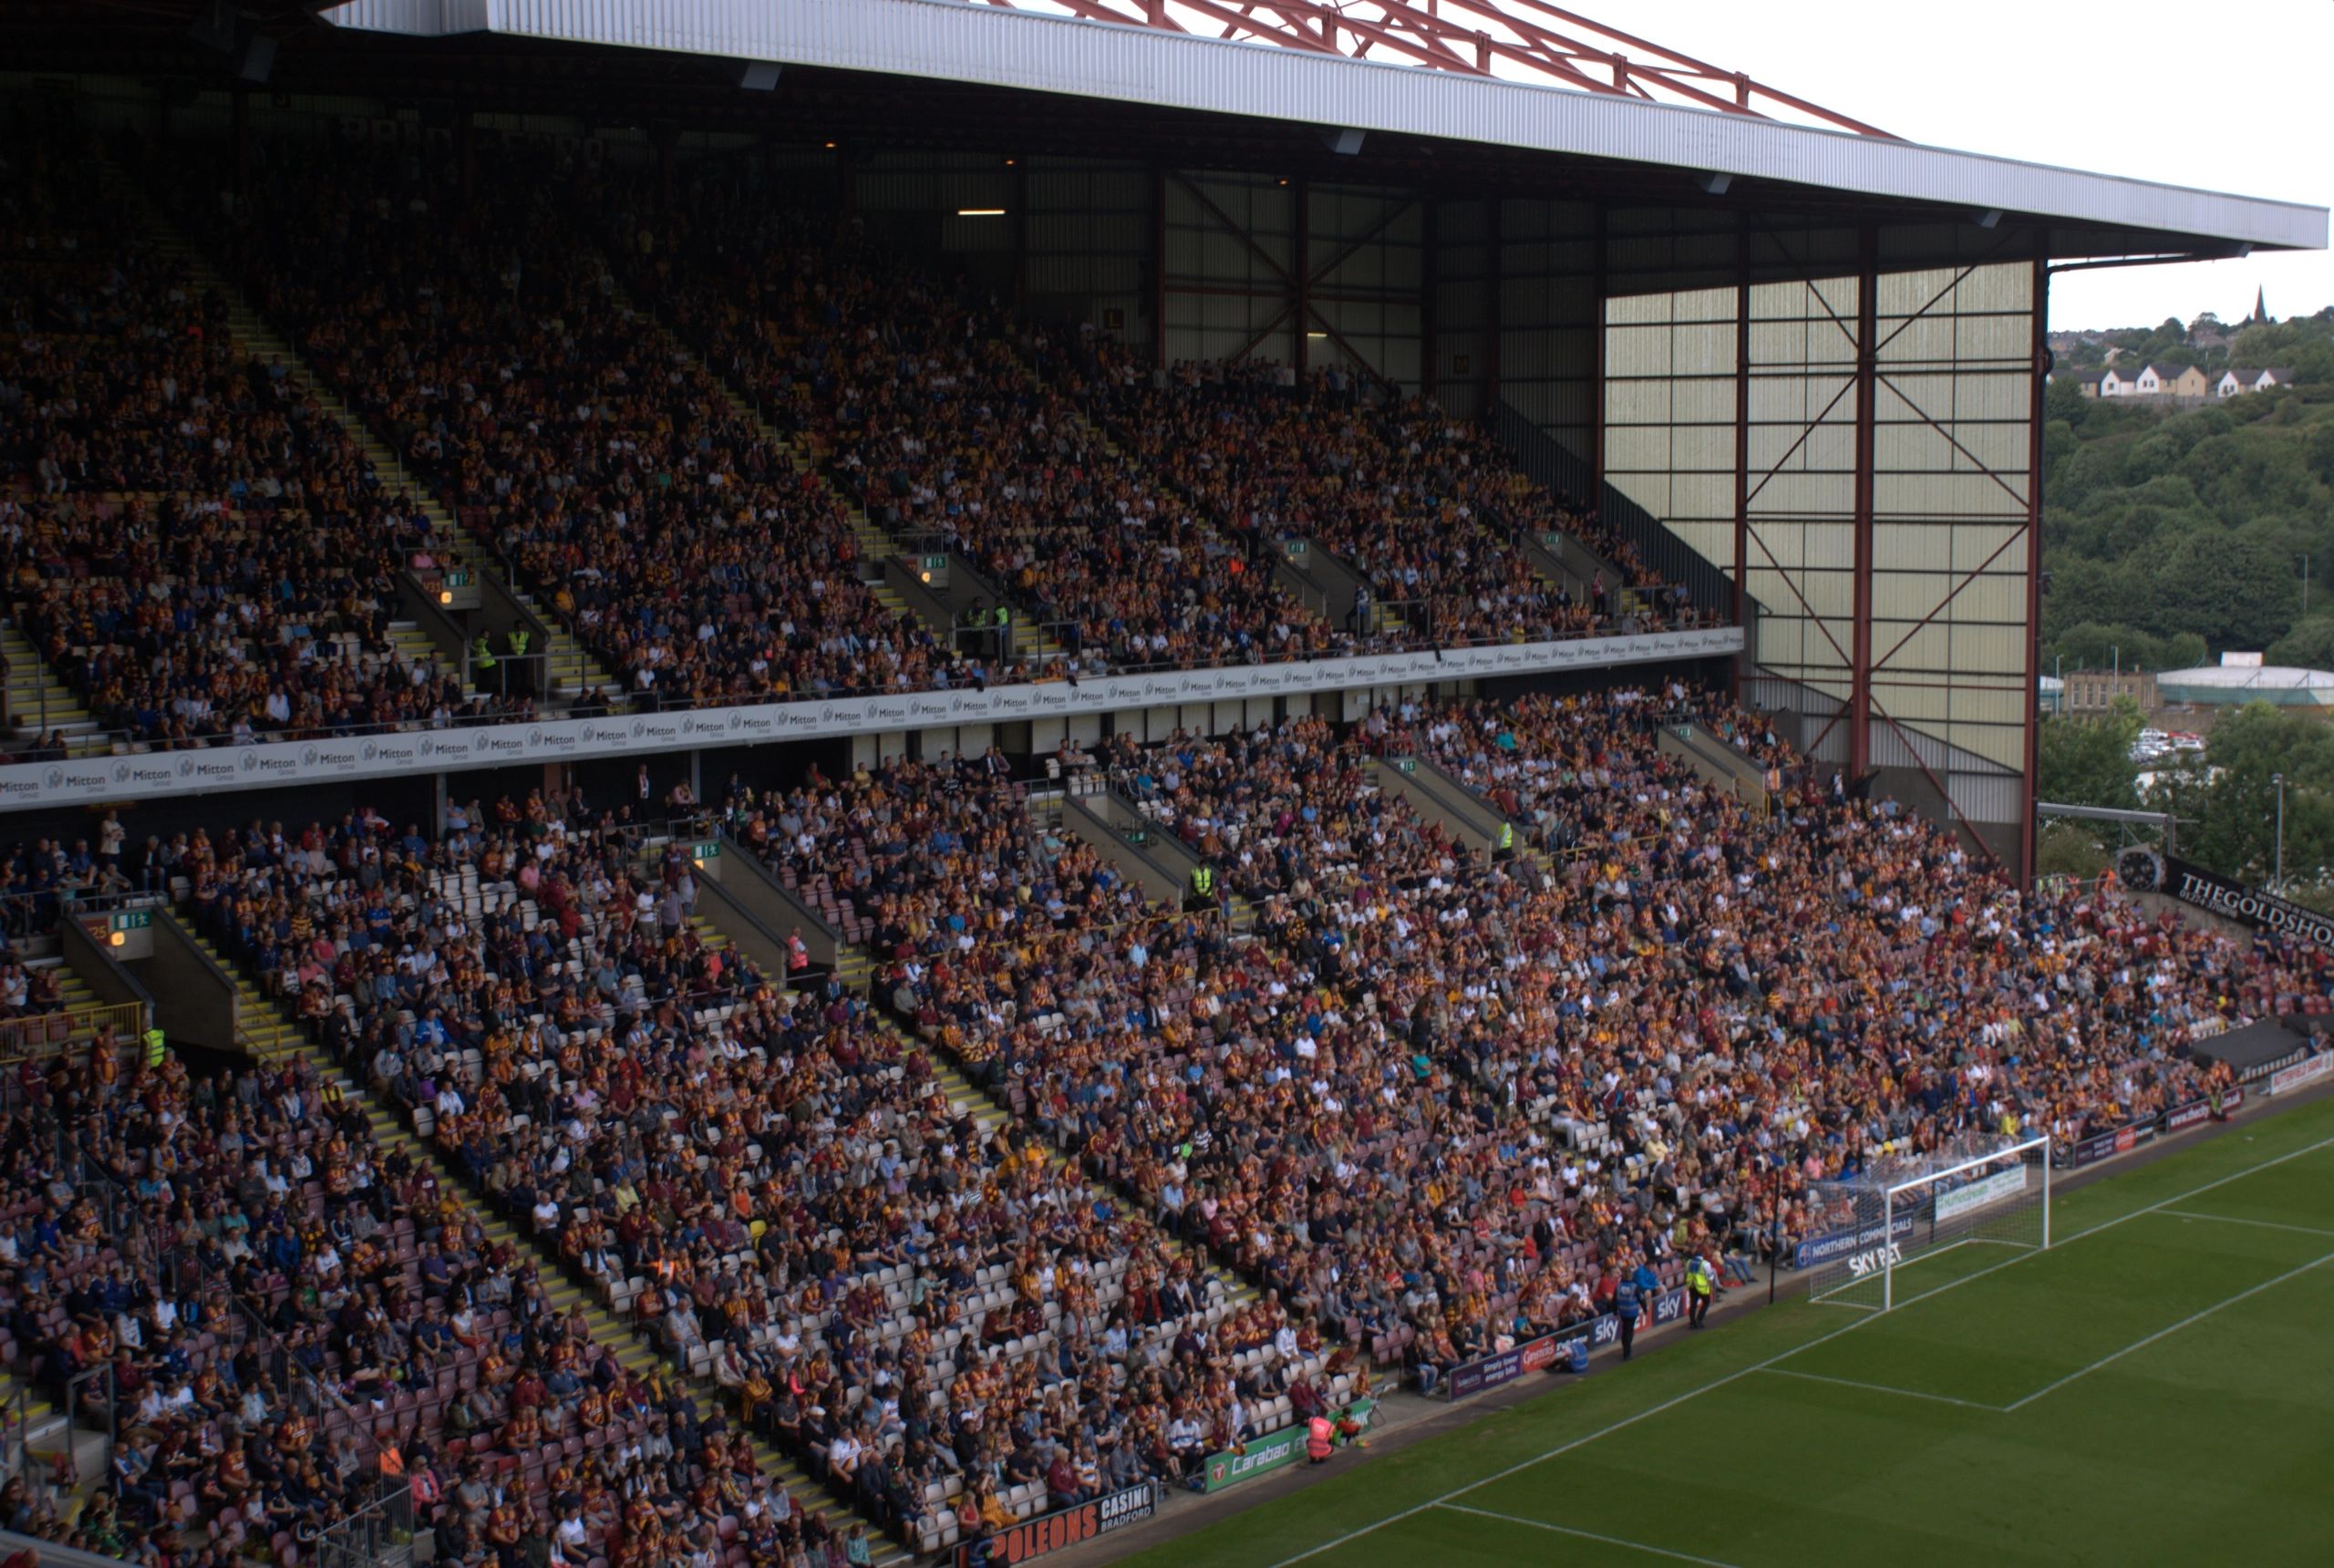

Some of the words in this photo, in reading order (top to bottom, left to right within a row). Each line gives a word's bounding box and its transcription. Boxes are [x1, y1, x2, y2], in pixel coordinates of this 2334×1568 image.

[1109, 311, 1120, 326] L
[1292, 675, 1312, 683] Mitton
[1154, 686, 1176, 694] Mitton
[1190, 683, 1212, 691] Mitton
[1080, 692, 1103, 700] Mitton
[1119, 689, 1140, 697] Mitton
[1004, 698, 1027, 707] Mitton
[1043, 696, 1066, 704] Mitton
[922, 705, 946, 714] Mitton
[964, 702, 987, 710] Mitton
[834, 712, 861, 721] Mitton
[879, 707, 904, 717] Mitton
[743, 719, 770, 728] Mitton
[790, 715, 817, 725] Mitton
[646, 727, 676, 737] Mitton
[696, 723, 724, 732] Mitton
[544, 736, 574, 745] Mitton
[596, 731, 626, 740] Mitton
[491, 739, 522, 749] Mitton
[379, 749, 412, 759] Mitton
[436, 744, 468, 755] Mitton
[260, 758, 295, 769] Mitton
[320, 754, 355, 764] Mitton
[133, 769, 170, 780] Mitton
[198, 764, 233, 775] Mitton
[67, 776, 105, 787] Mitton
[0, 782, 38, 792] Mitton
[2183, 872, 2334, 948] THEGOLDSHO
[1812, 1235, 1857, 1257] NORTHERN
[1859, 1217, 1912, 1244] COMMECIALS
[1848, 1250, 1876, 1276] SKY
[1658, 1295, 1680, 1319] sky
[1596, 1317, 1618, 1341] sky
[1232, 1441, 1290, 1475] Carabao
[1100, 1485, 1151, 1520] CASINO
[1100, 1506, 1152, 1532] BRADFORD
